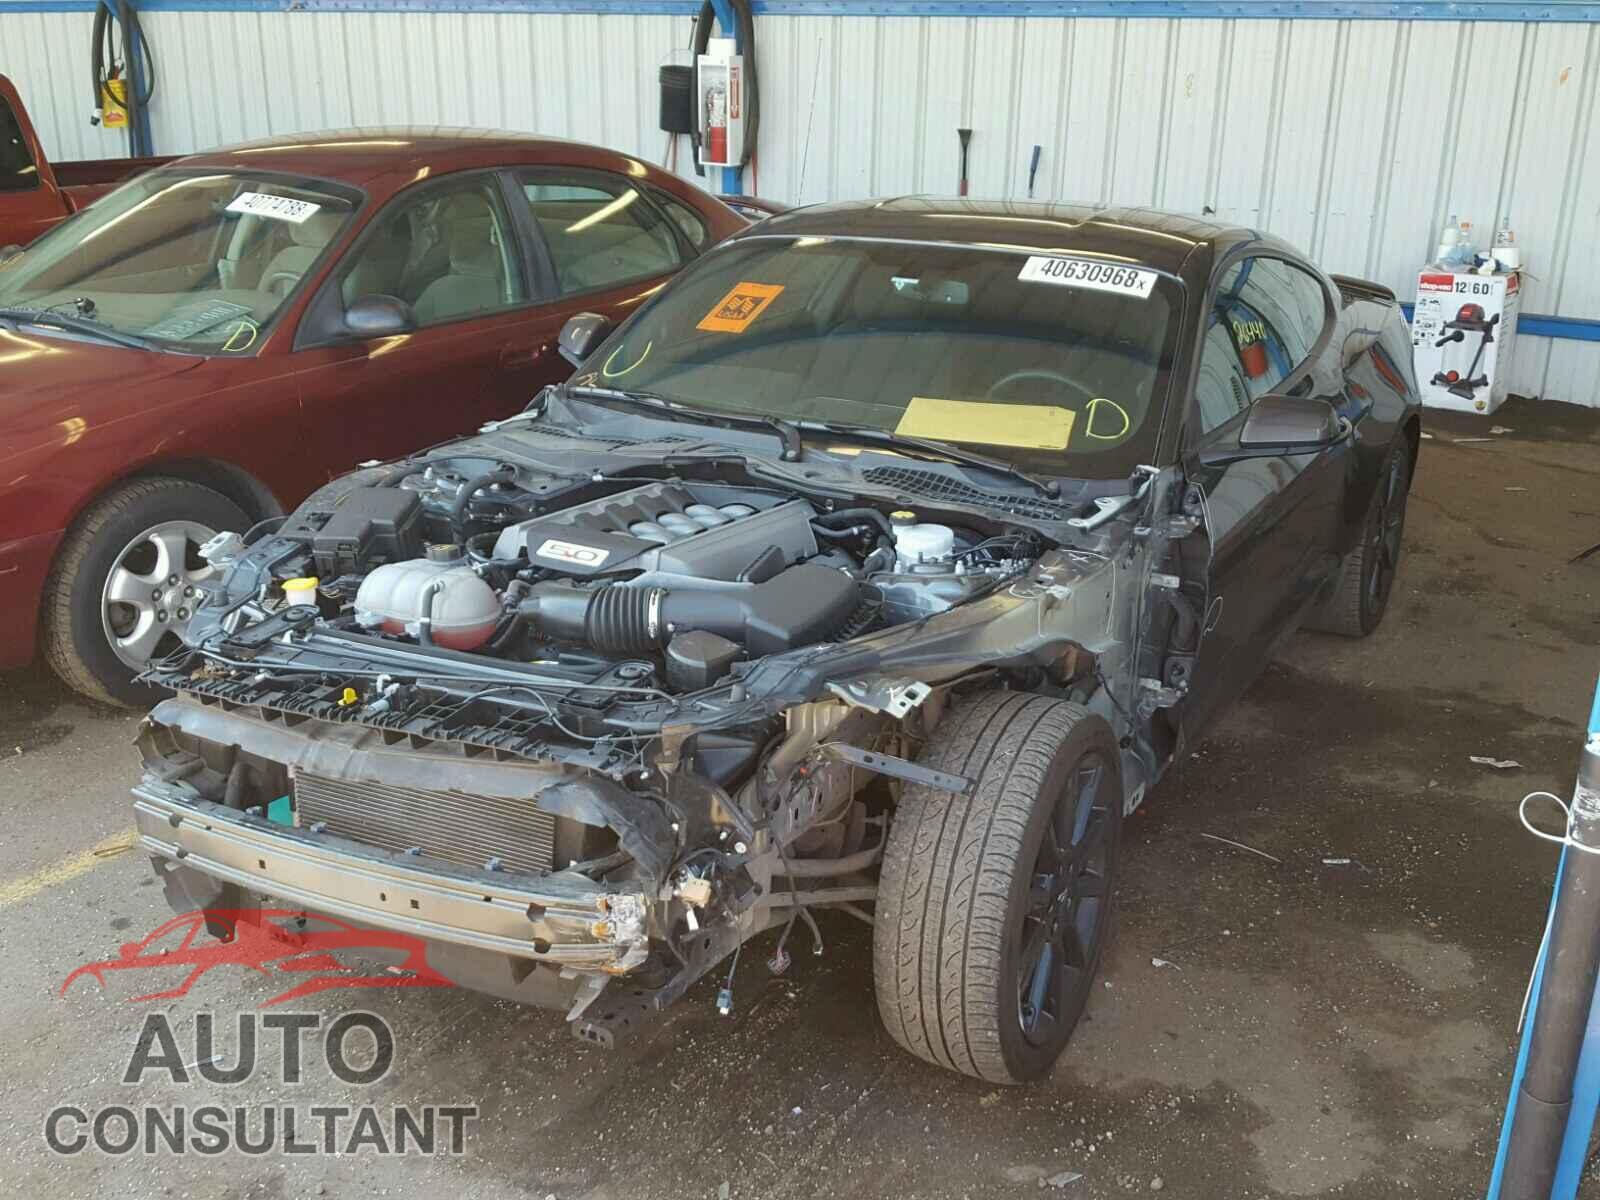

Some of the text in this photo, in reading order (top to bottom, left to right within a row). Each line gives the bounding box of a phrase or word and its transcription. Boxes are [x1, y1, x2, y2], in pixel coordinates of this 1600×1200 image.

[1455, 282, 1467, 294] 12
[1086, 398, 1129, 439] D
[546, 543, 598, 561] 5.0
